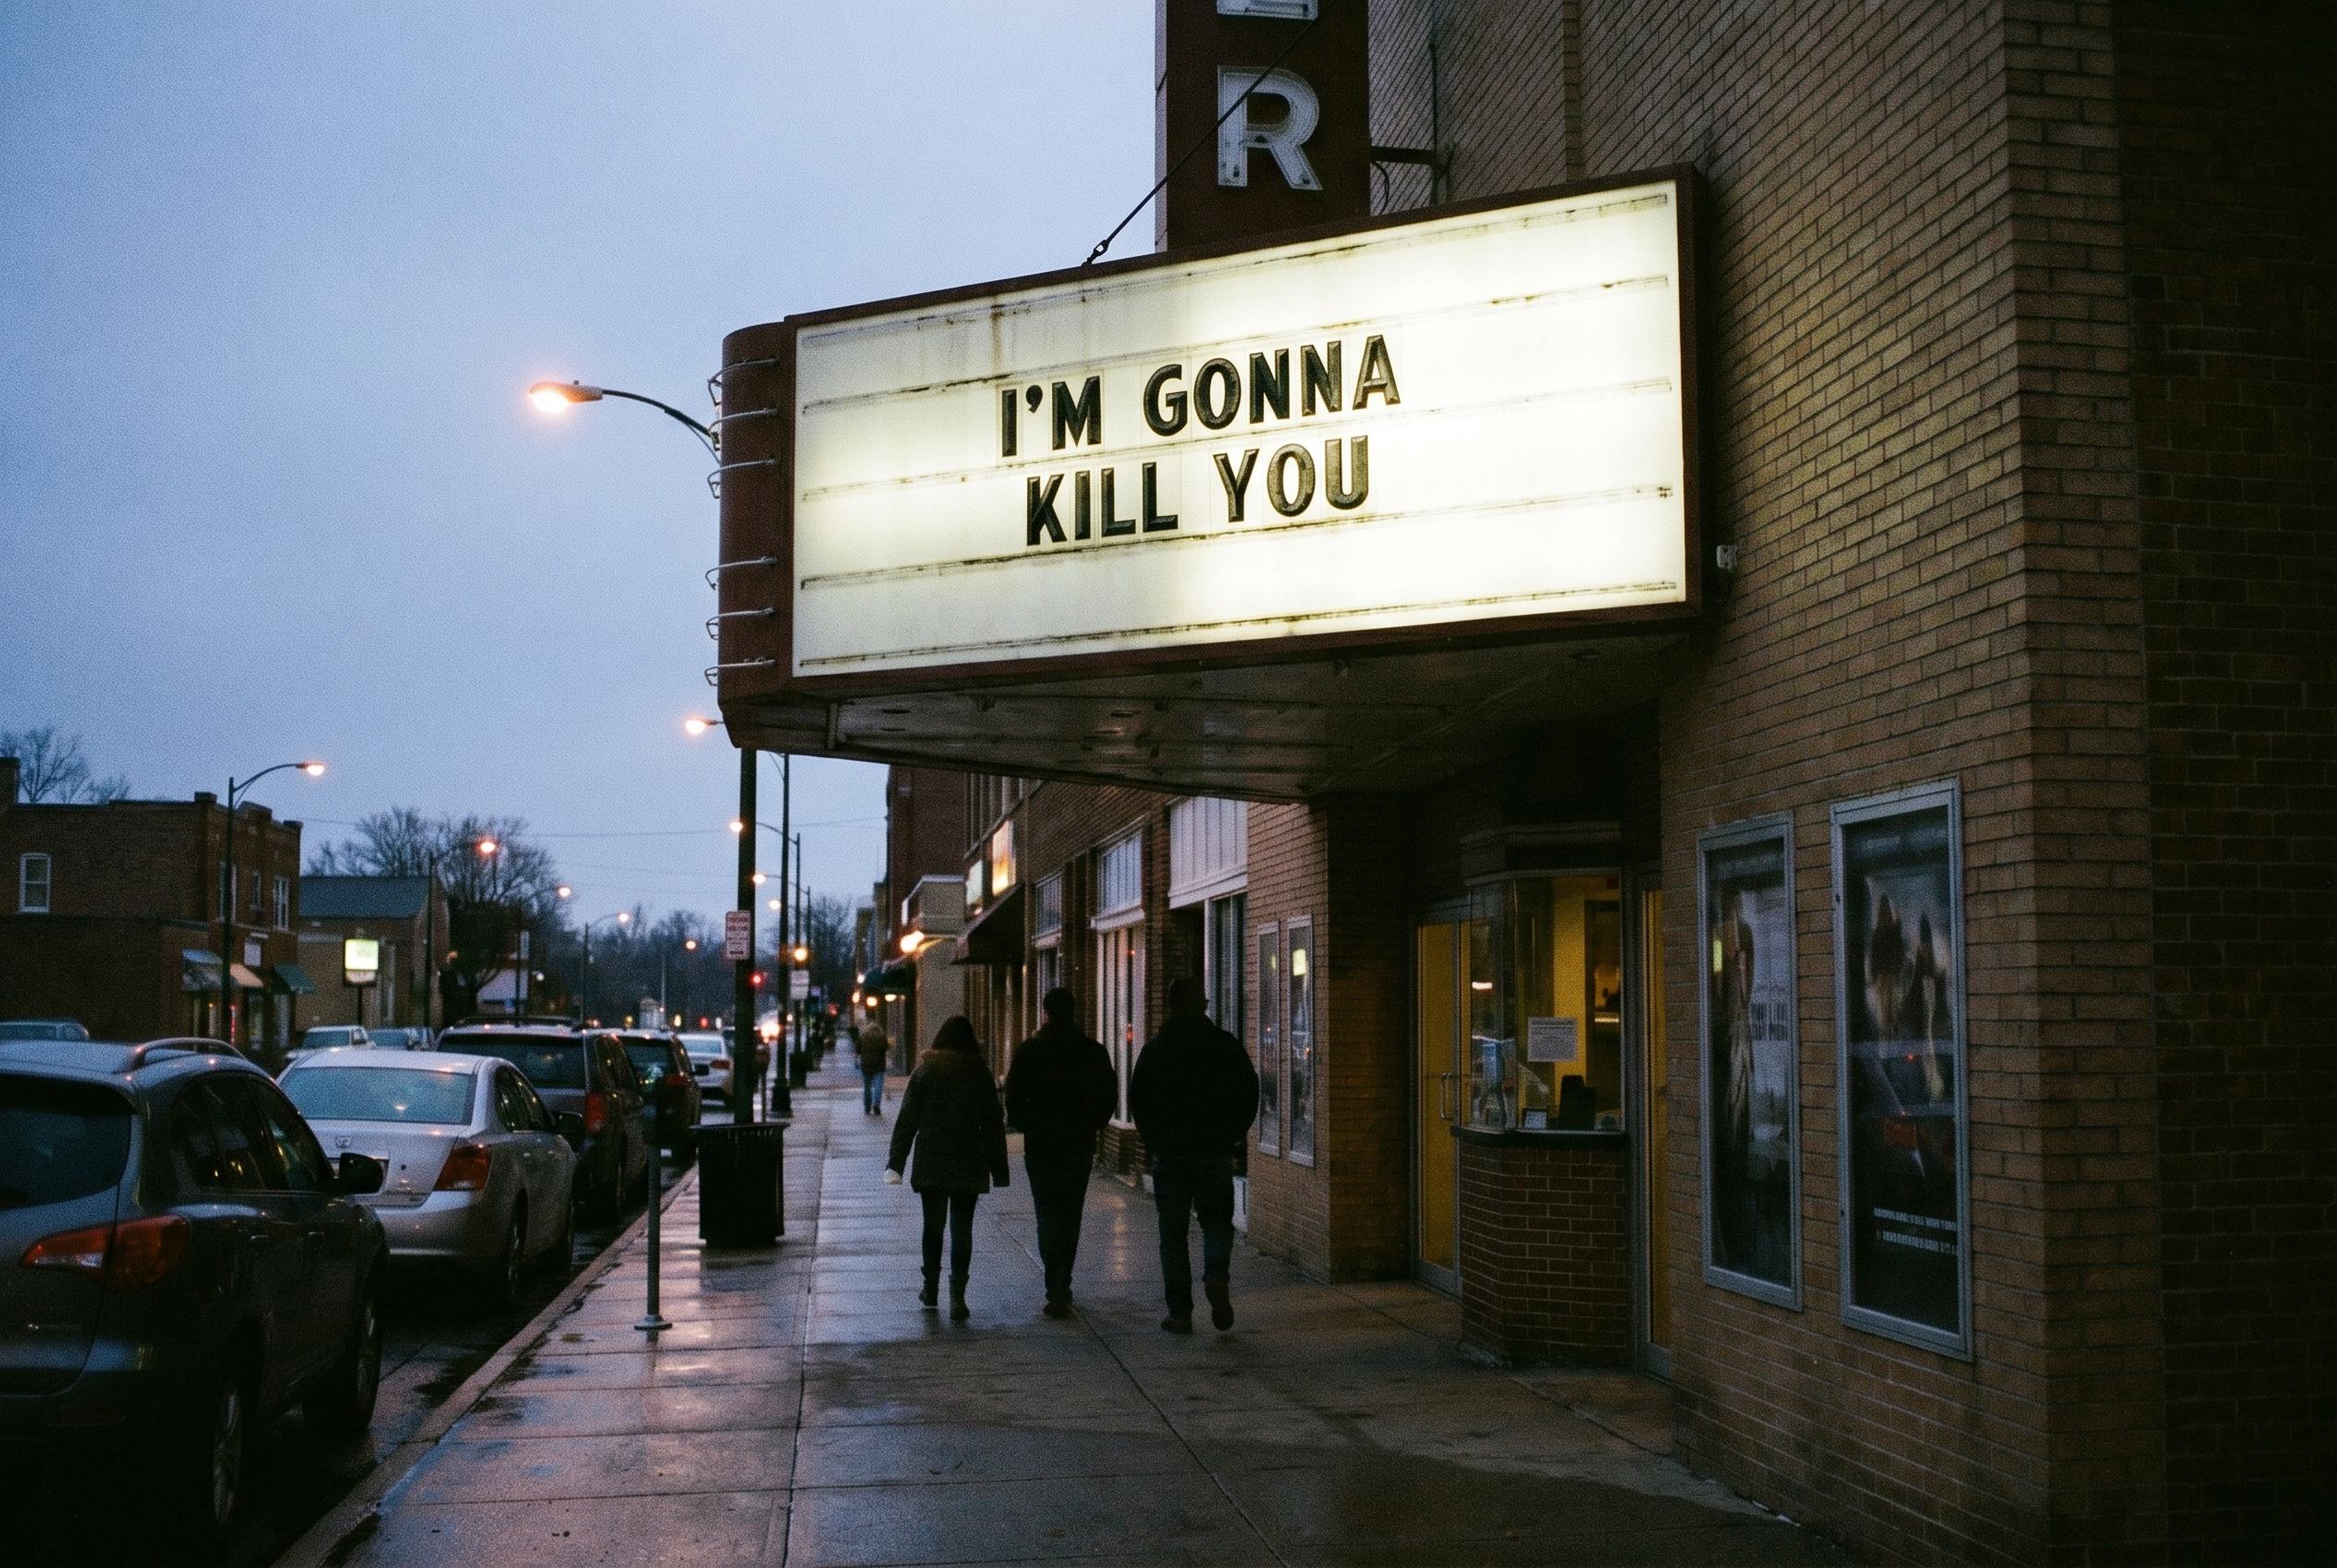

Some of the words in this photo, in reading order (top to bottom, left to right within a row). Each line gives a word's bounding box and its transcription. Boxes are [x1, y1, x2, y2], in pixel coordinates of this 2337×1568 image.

[1217, 0, 1323, 190] R
[1001, 375, 1102, 457] I'M
[1143, 334, 1401, 436] GONNA
[1026, 461, 1179, 546] KILL
[1213, 435, 1369, 522] YOU
